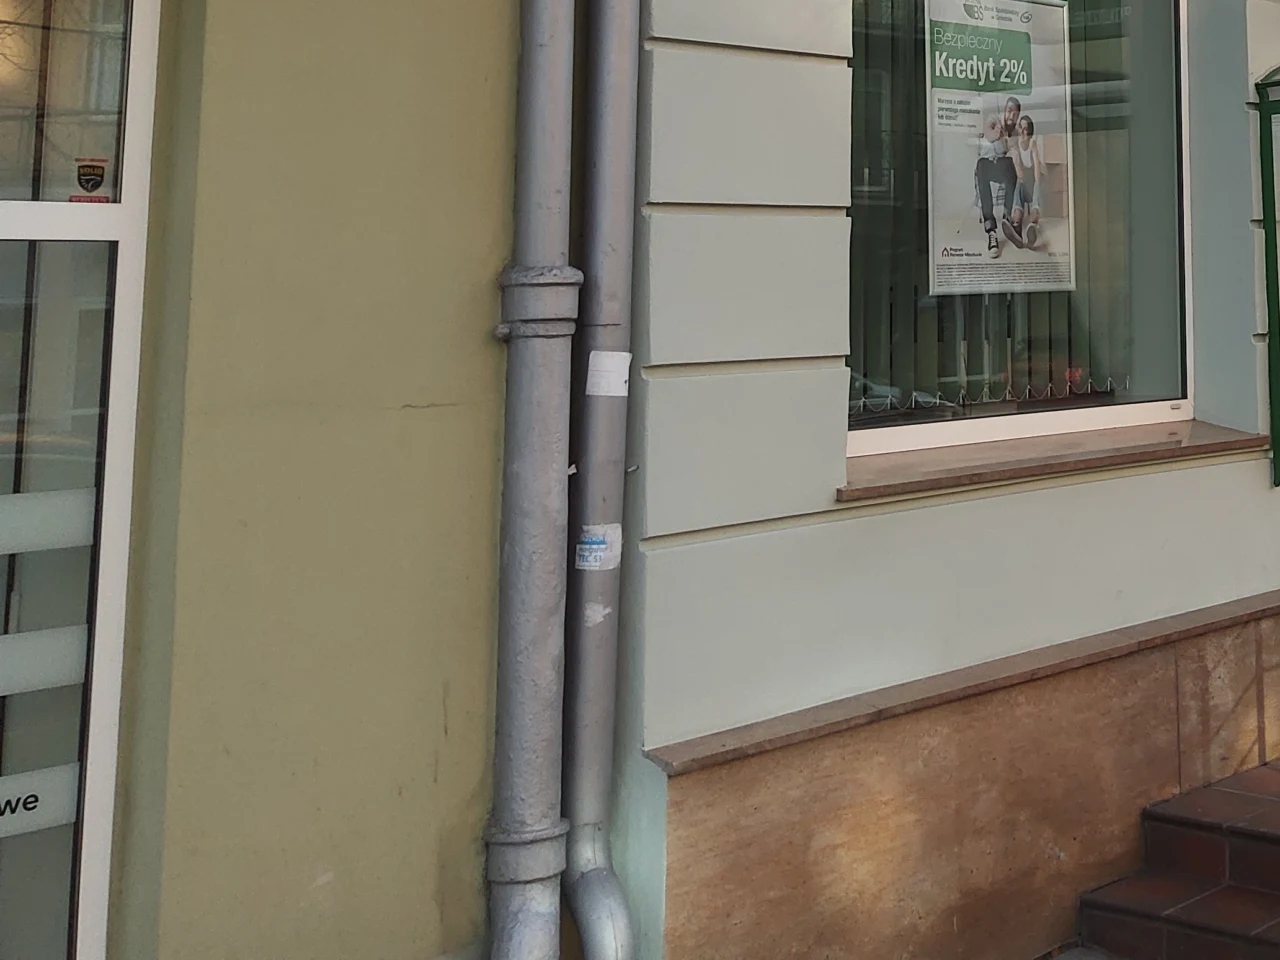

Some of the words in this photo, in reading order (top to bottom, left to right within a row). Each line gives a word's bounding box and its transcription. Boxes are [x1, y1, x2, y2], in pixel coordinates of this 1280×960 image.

[934, 27, 1003, 54] Bezpieczny
[935, 51, 995, 86] Kredyt
[1000, 58, 1027, 85] 2%
